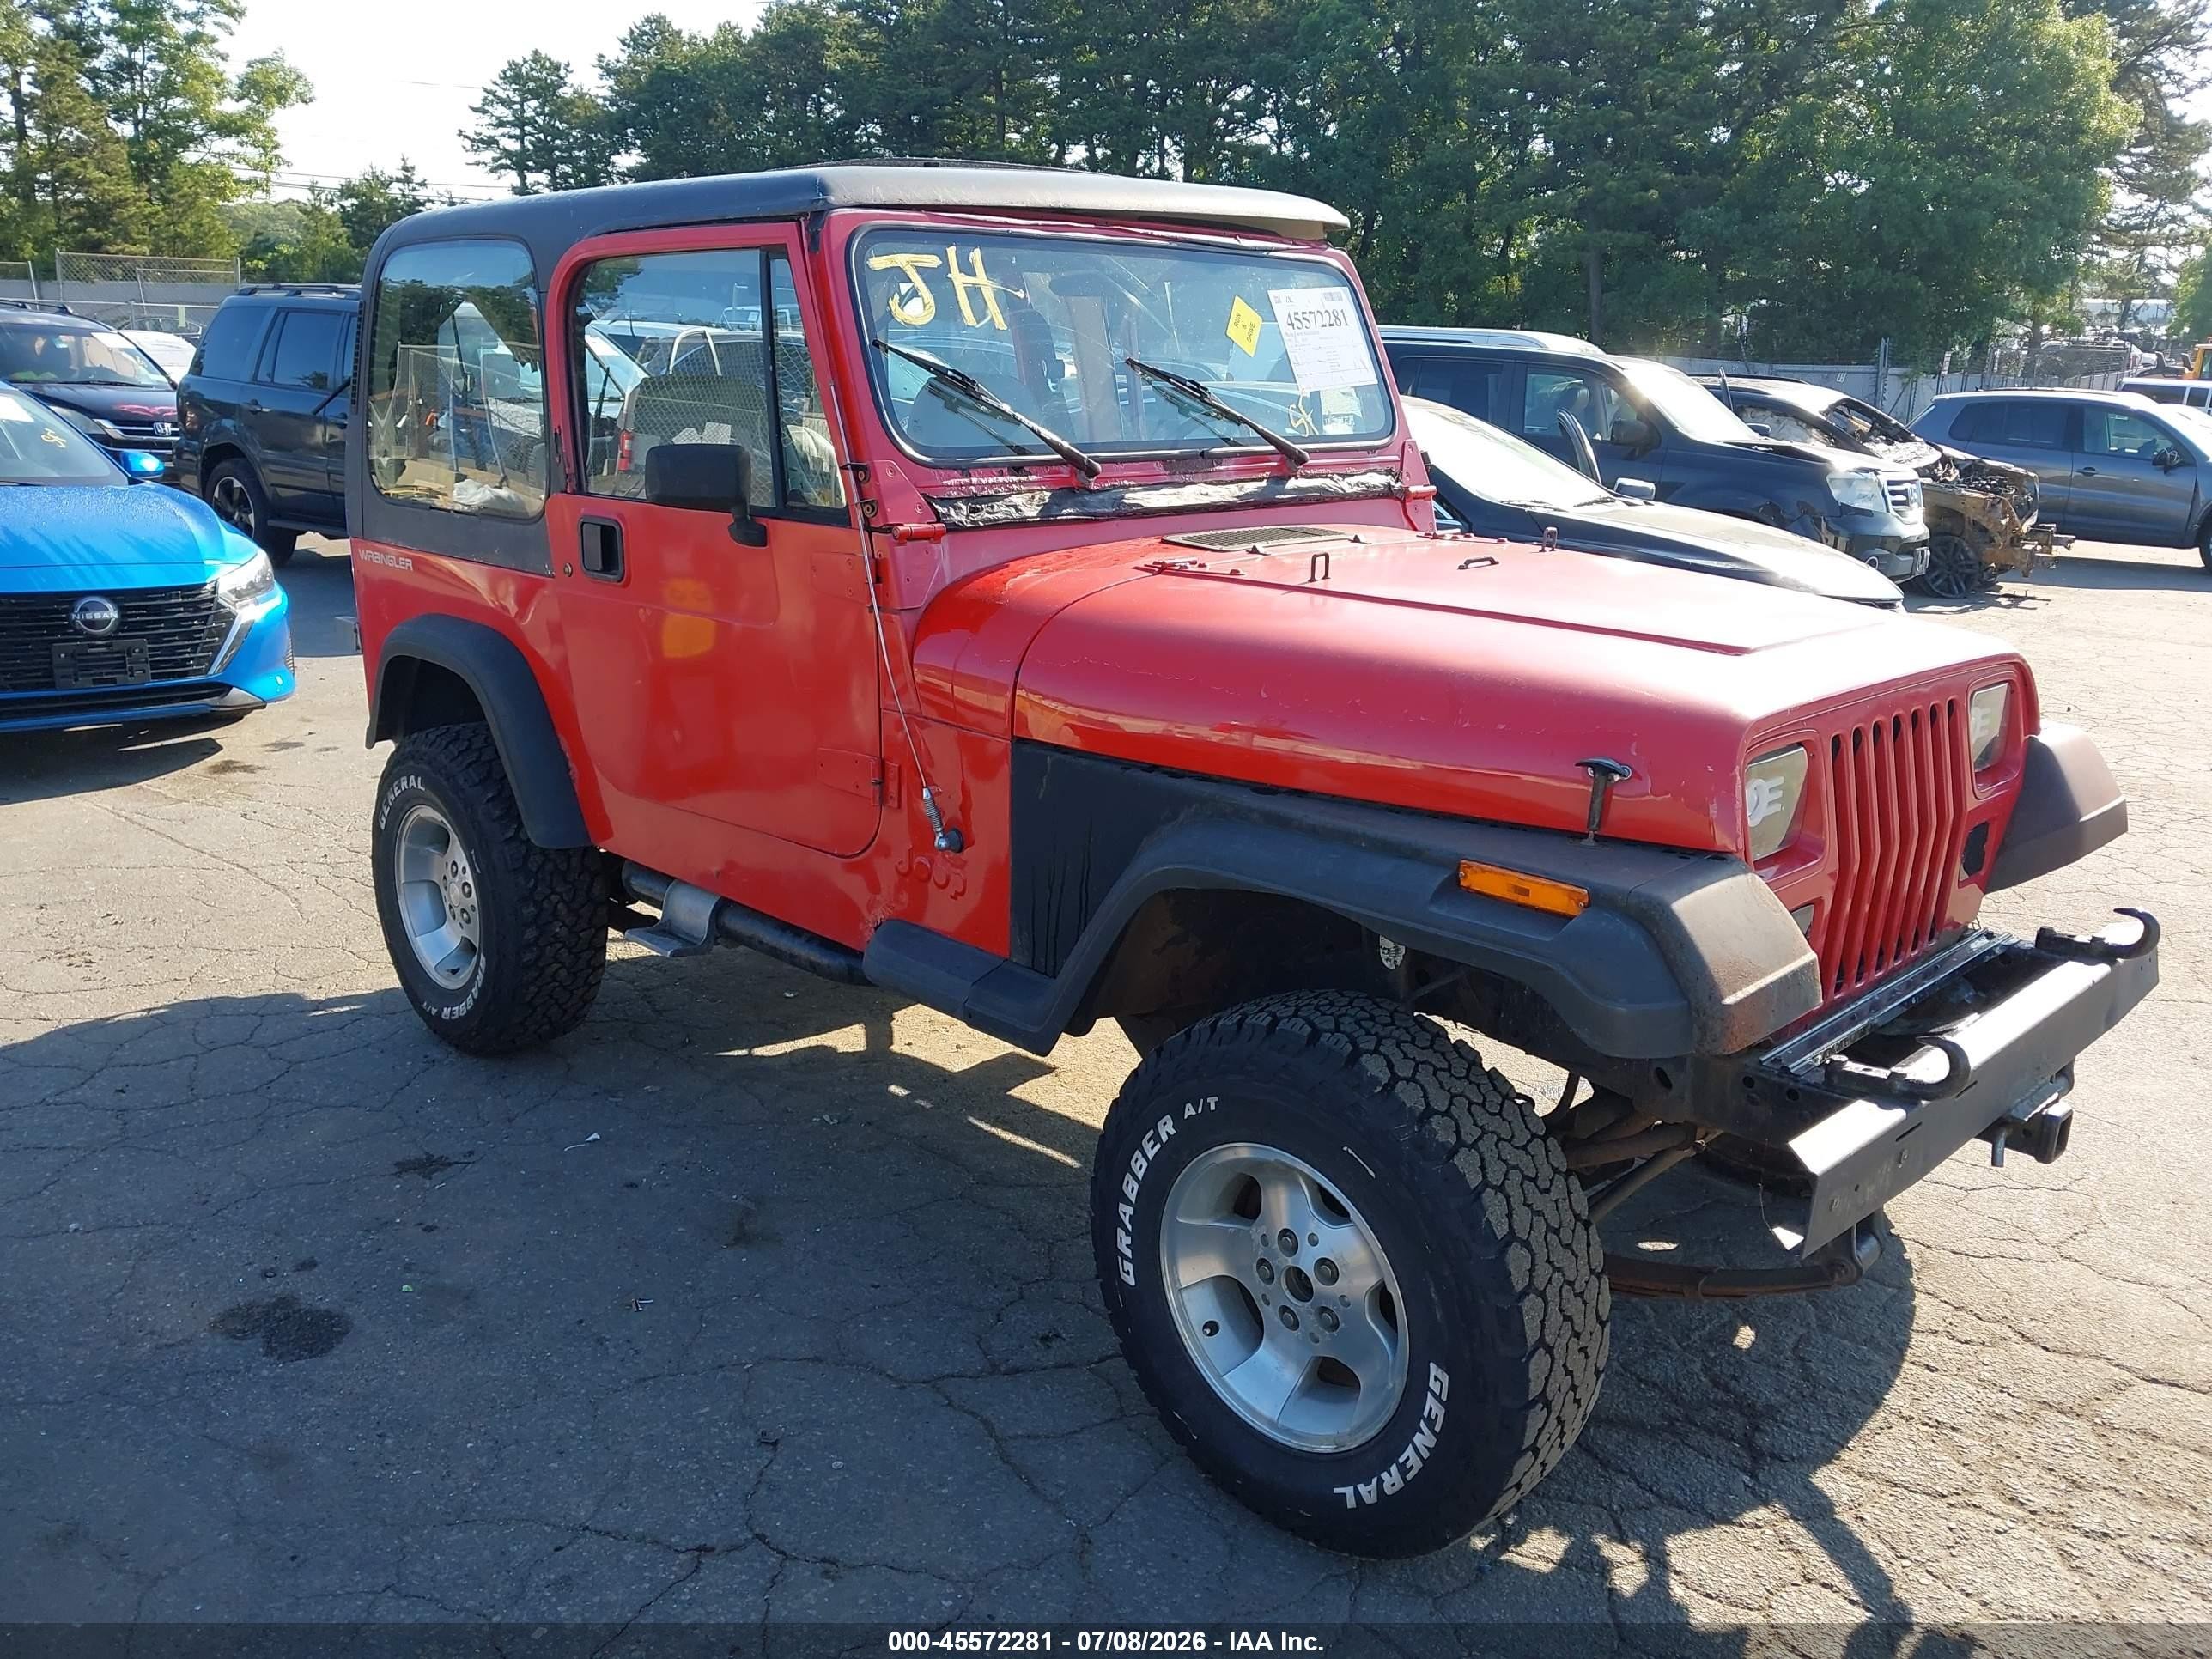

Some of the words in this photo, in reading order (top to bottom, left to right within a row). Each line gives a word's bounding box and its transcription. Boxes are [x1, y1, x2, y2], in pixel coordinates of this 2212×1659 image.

[1247, 322, 1255, 343] DRIVE
[1286, 308, 1349, 331] 45572281
[358, 549, 413, 571] WRANGLER
[71, 611, 118, 620] NISSAN
[379, 775, 426, 830] GENERAL
[441, 952, 487, 1020] GRABBER
[1116, 1114, 1177, 1286] GRABBER
[1183, 1096, 1219, 1120] A/T
[1333, 1361, 1449, 1510] GENERAL
